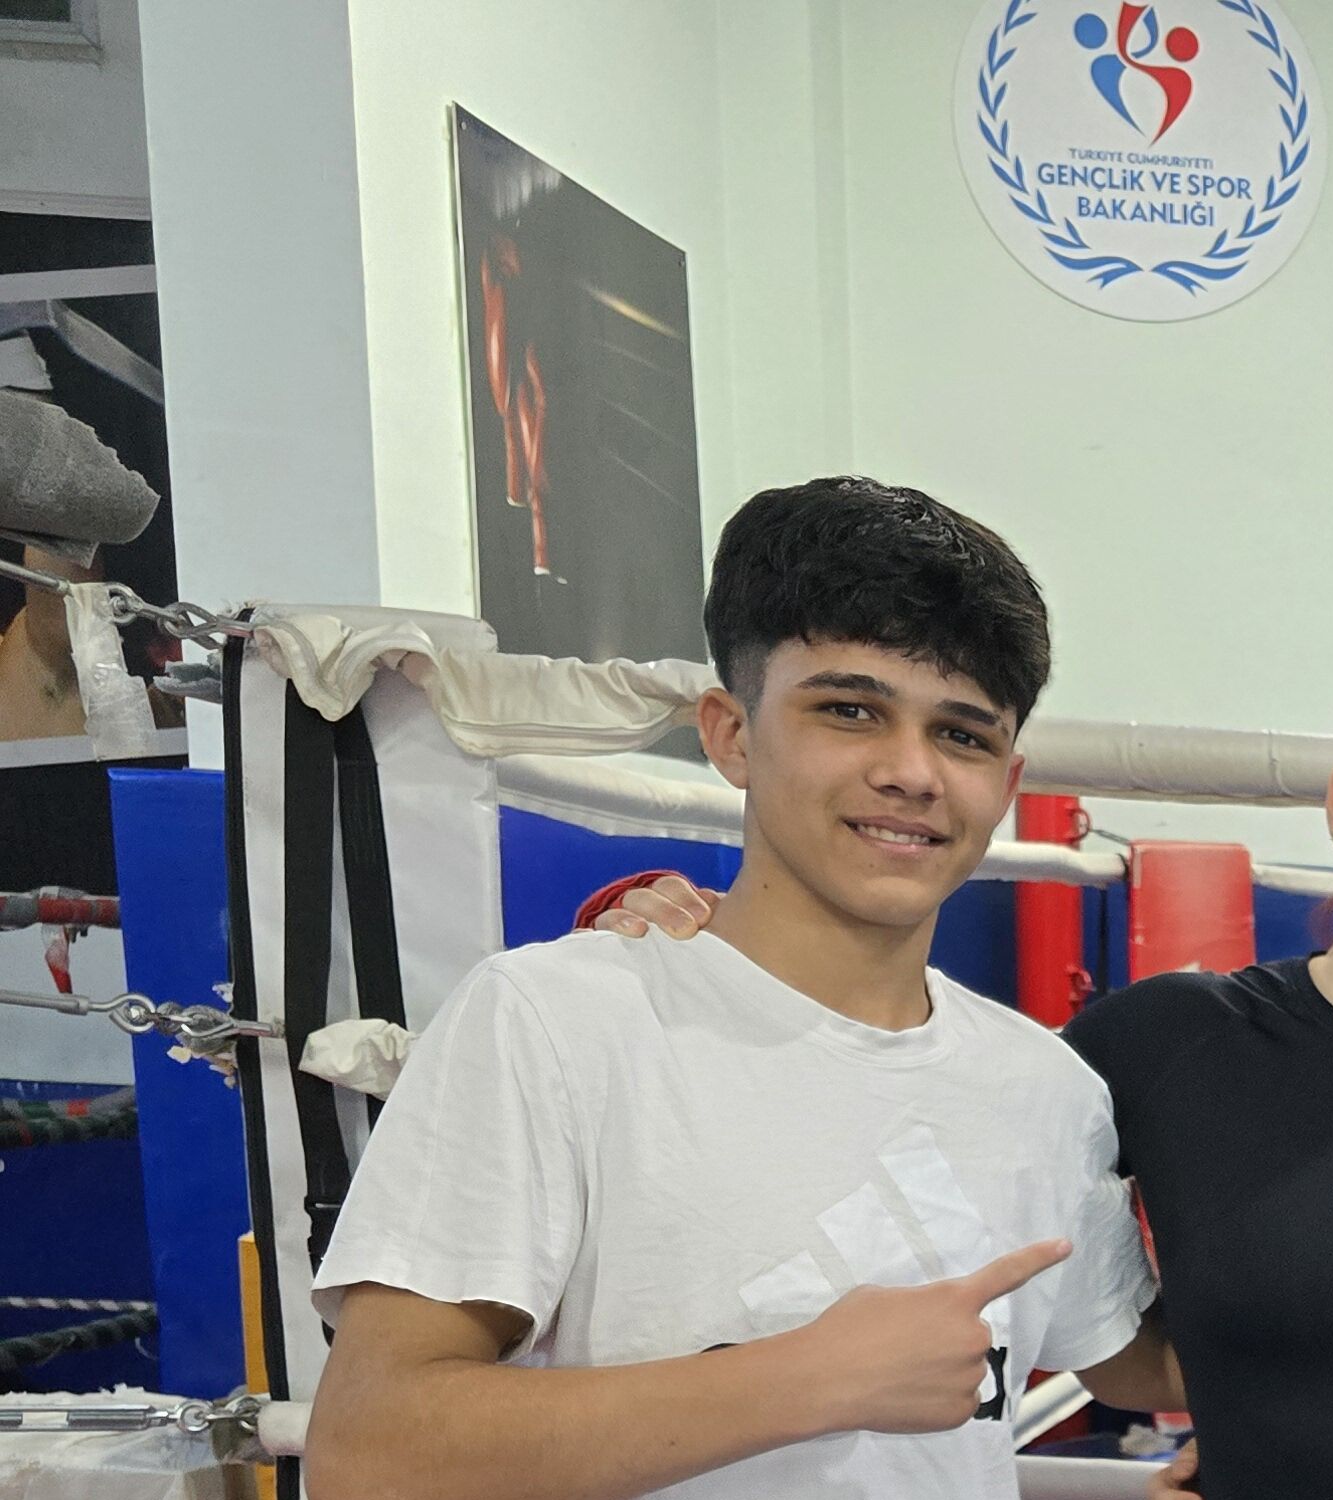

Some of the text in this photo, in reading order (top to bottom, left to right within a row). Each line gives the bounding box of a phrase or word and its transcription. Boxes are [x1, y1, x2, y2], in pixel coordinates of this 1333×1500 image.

[1150, 171, 1181, 194] VE
[1188, 174, 1252, 200] SPOR
[1077, 196, 1214, 227] BAKANLIĞI
